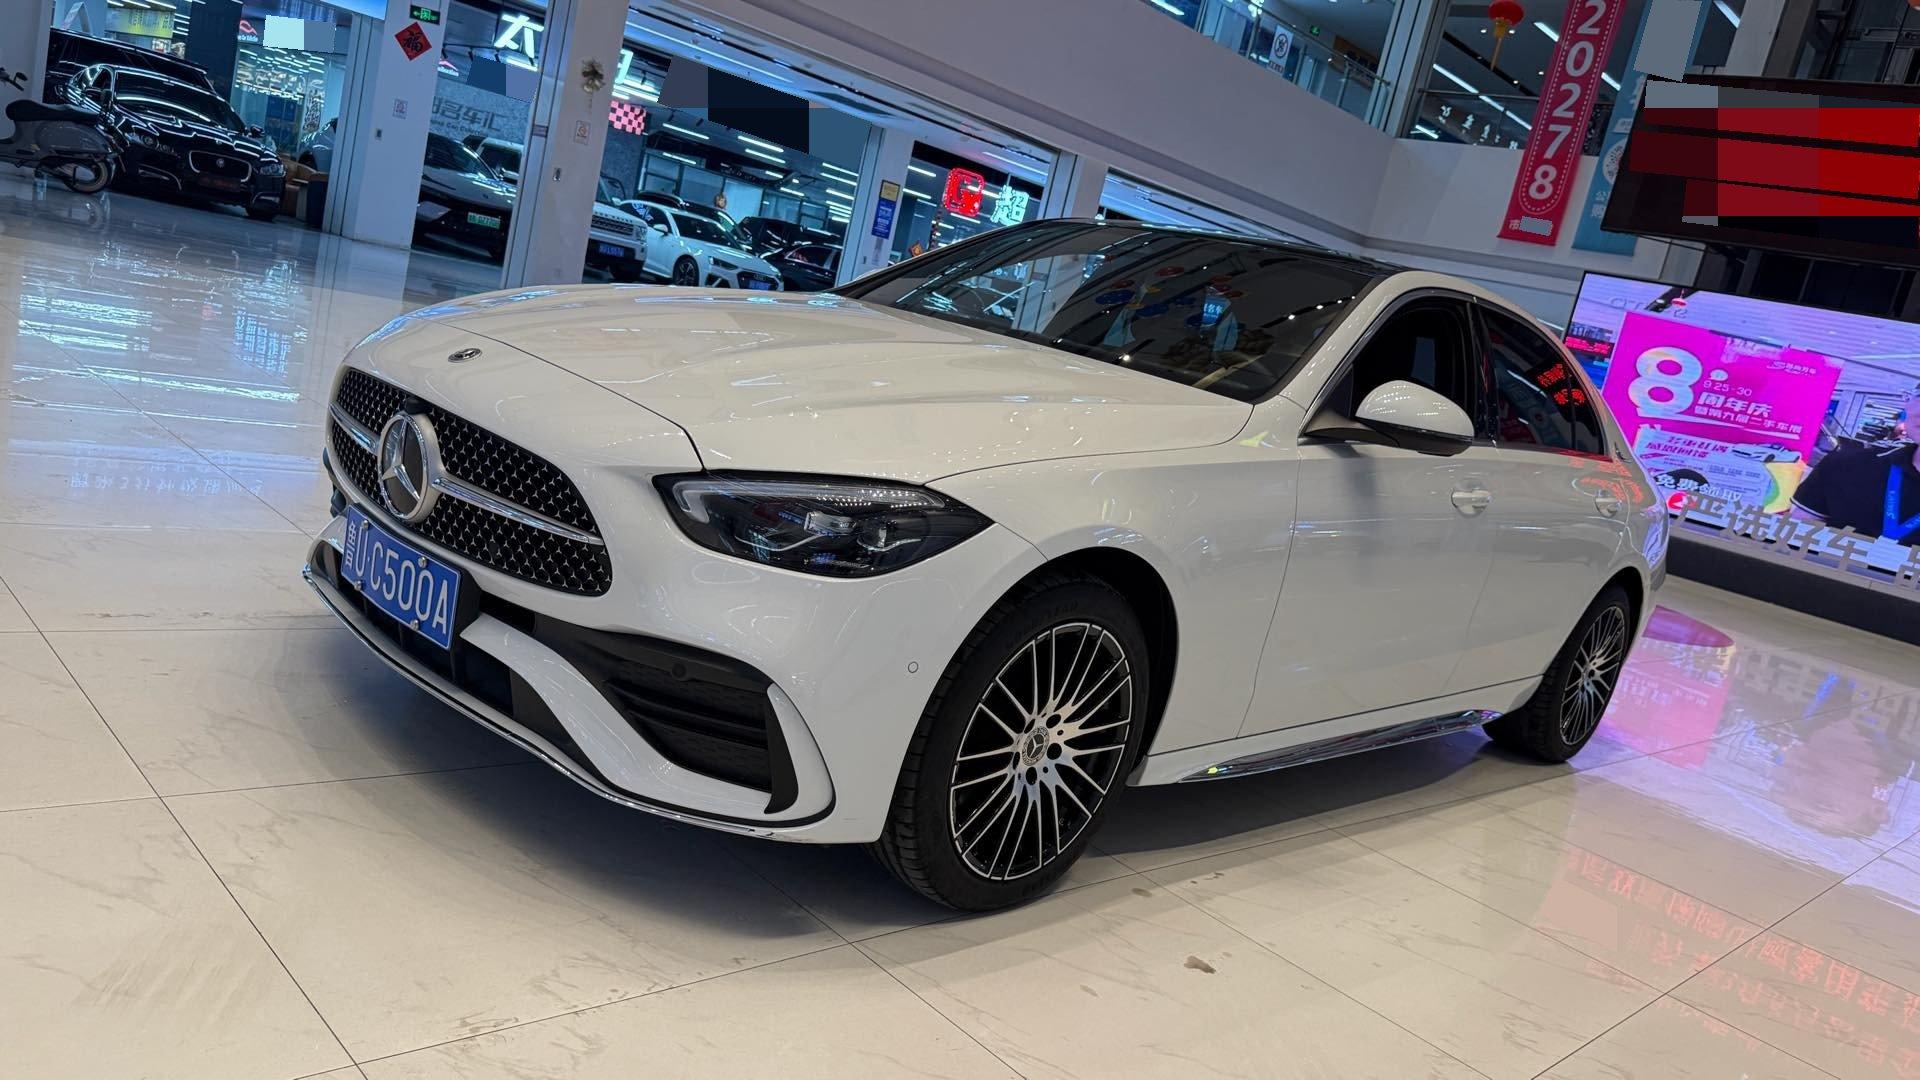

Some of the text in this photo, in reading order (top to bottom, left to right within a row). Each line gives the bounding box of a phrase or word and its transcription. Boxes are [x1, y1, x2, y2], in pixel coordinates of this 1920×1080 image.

[1528, 0, 1607, 200] 20278
[1698, 391, 1773, 418] 周年庆
